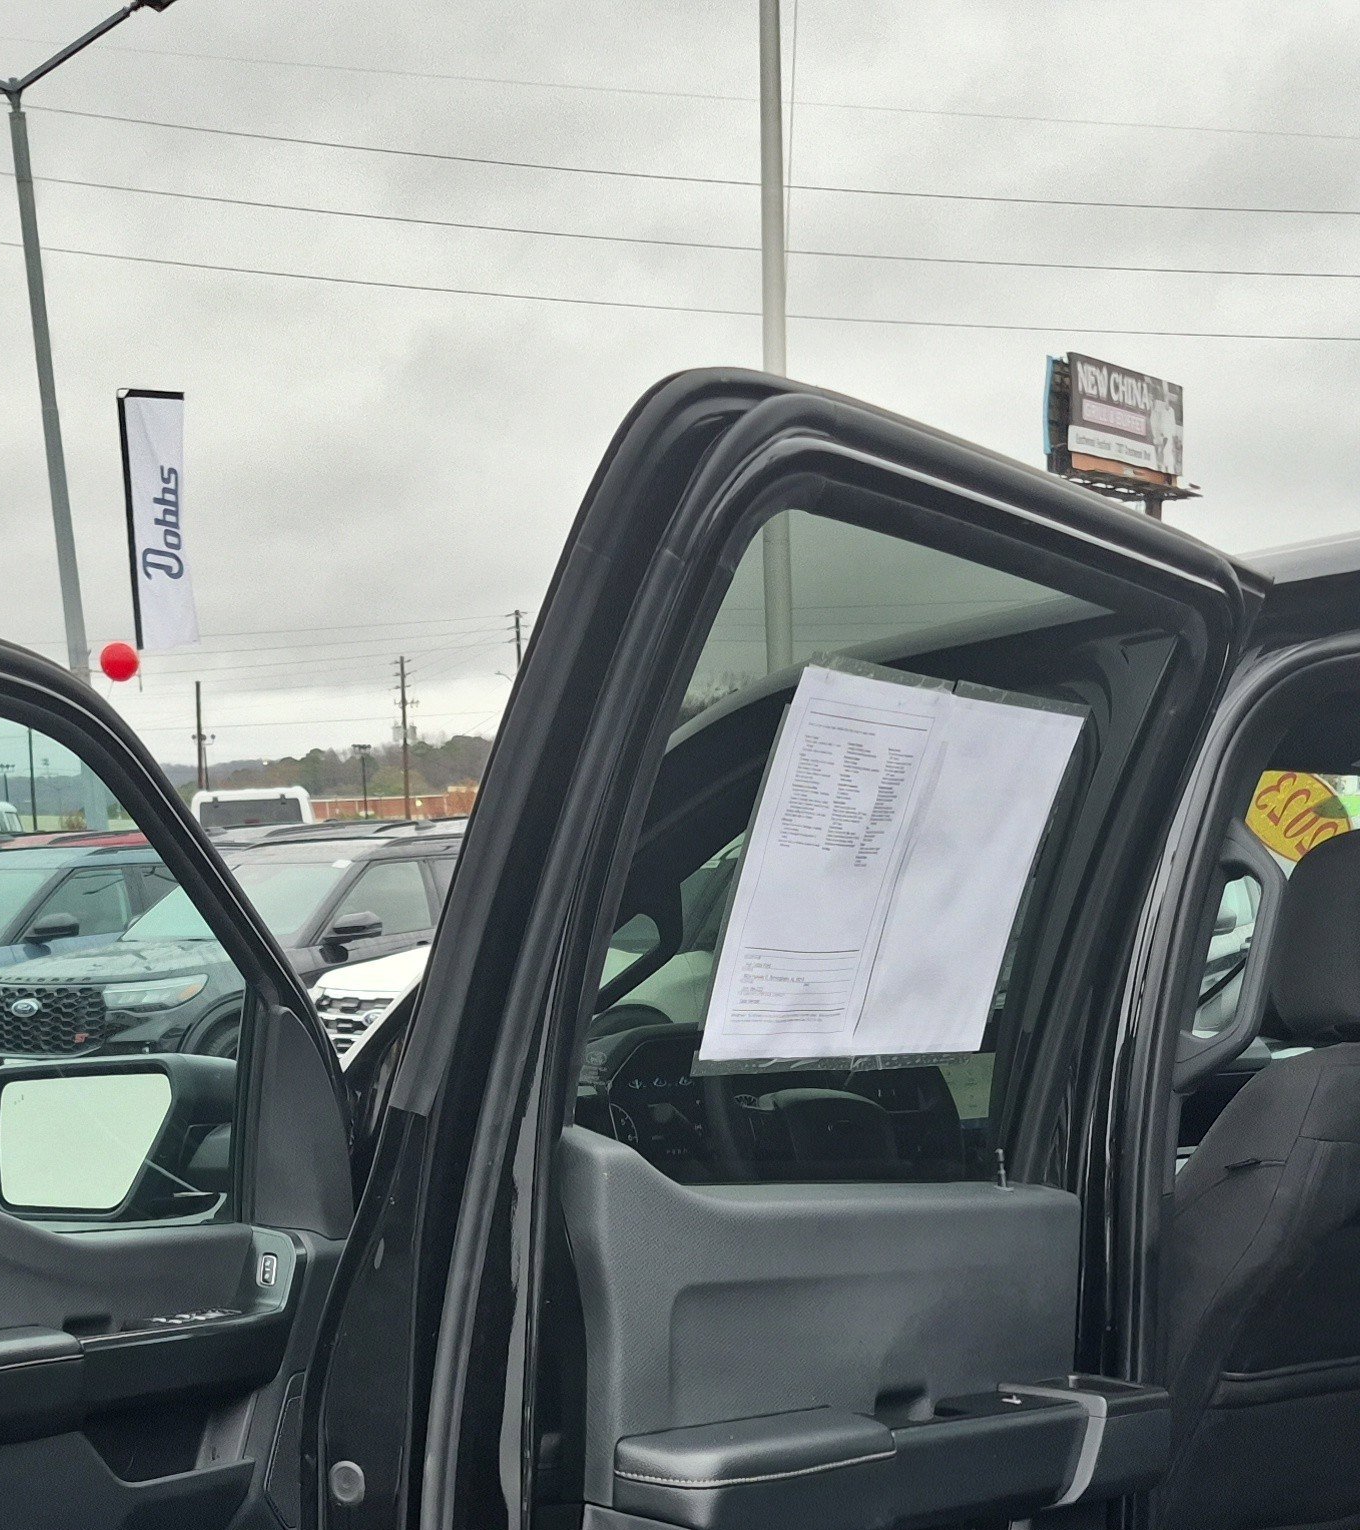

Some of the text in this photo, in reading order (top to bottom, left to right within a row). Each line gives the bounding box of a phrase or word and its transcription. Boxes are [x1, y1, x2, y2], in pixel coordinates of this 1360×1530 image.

[1076, 361, 1152, 411] NEW CHINA
[141, 465, 184, 580] Dobbs
